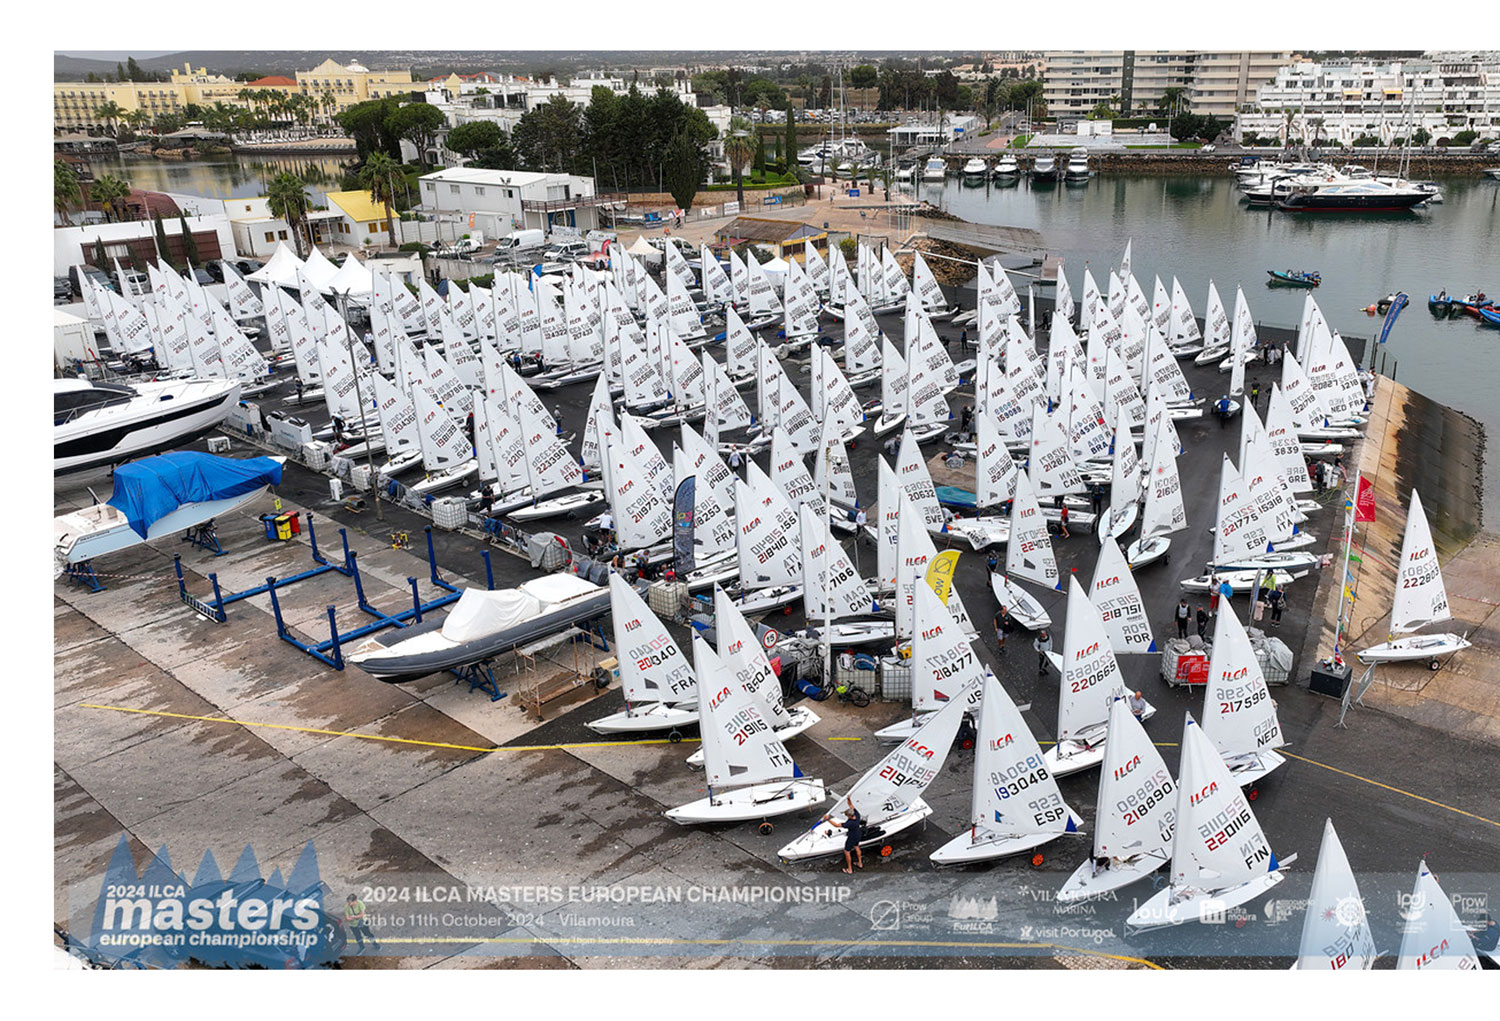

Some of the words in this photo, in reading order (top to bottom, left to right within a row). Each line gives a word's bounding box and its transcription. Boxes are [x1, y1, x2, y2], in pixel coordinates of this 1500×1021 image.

[715, 530, 735, 546] FRA
[1246, 536, 1267, 550] ESP
[757, 536, 788, 564] 218410
[905, 556, 927, 566] ILCA
[1097, 576, 1120, 590] ILCA
[850, 595, 872, 613] CAN
[1102, 604, 1142, 621] 218751
[1432, 600, 1447, 615] FRA
[766, 633, 775, 643] 15
[922, 626, 944, 642] ILCA
[1125, 633, 1150, 645] POR
[1076, 642, 1099, 660] ILCA
[932, 653, 974, 681] 218477
[1222, 667, 1247, 681] ILCA
[671, 671, 697, 695] FRA
[1071, 662, 1116, 693] 220665
[709, 687, 732, 712] ILCA
[1221, 688, 1266, 714] 217596
[733, 719, 768, 746] 219115
[990, 734, 1014, 751] ILCA
[1257, 727, 1278, 747] NED
[905, 739, 935, 761] ILCA
[769, 753, 791, 768] ITA
[1114, 755, 1141, 781] ILCA
[994, 768, 1049, 800] 193048
[1190, 781, 1219, 807] ILCA
[1123, 781, 1173, 826] 218890
[1034, 807, 1065, 826] ESP
[1205, 809, 1251, 852] 220116
[1245, 847, 1269, 870] FIN
[1416, 939, 1449, 969] ILCA
